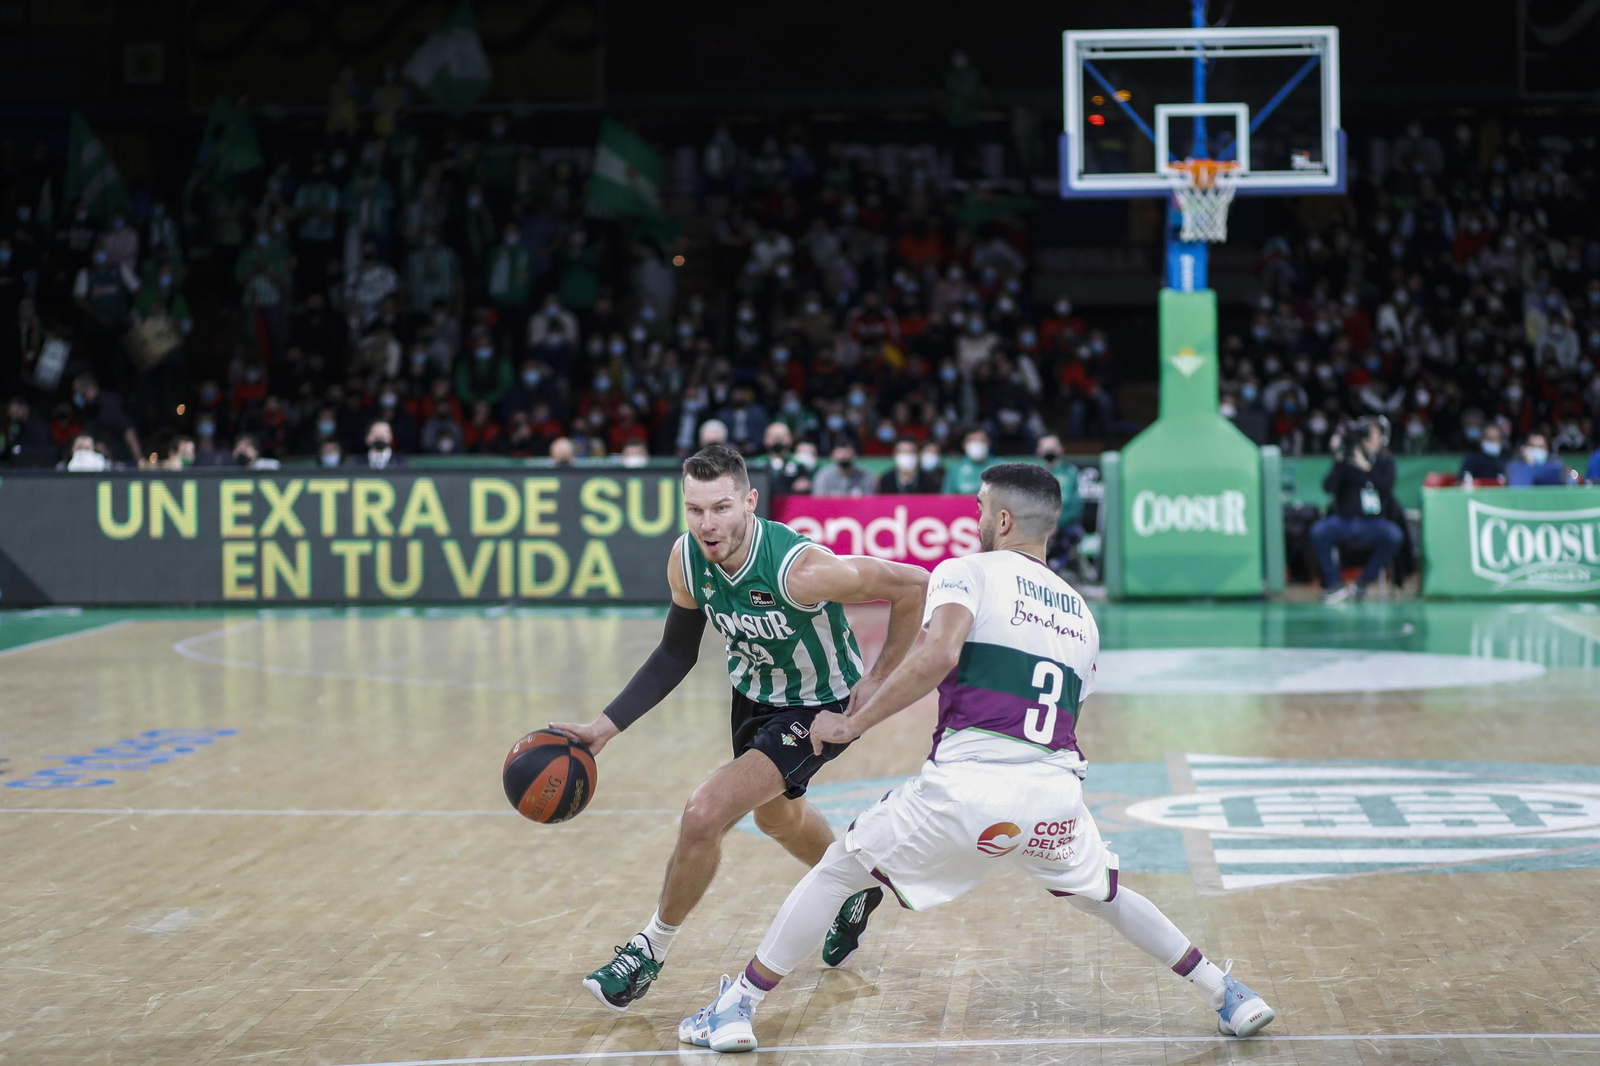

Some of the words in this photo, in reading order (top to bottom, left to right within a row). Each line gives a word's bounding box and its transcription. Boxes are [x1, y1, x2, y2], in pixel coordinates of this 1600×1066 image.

[98, 481, 197, 539] UN
[220, 478, 450, 538] EXTRA
[470, 478, 559, 537] DE
[579, 478, 688, 537] SU
[788, 505, 982, 561] endes
[1132, 489, 1248, 537] COOSUR
[222, 540, 311, 599] EN
[331, 541, 424, 598] TU
[442, 539, 624, 599] VIDA
[1480, 516, 1600, 571] COOSU
[1023, 660, 1064, 745] 3
[1021, 846, 1076, 861] MÁLAGA
